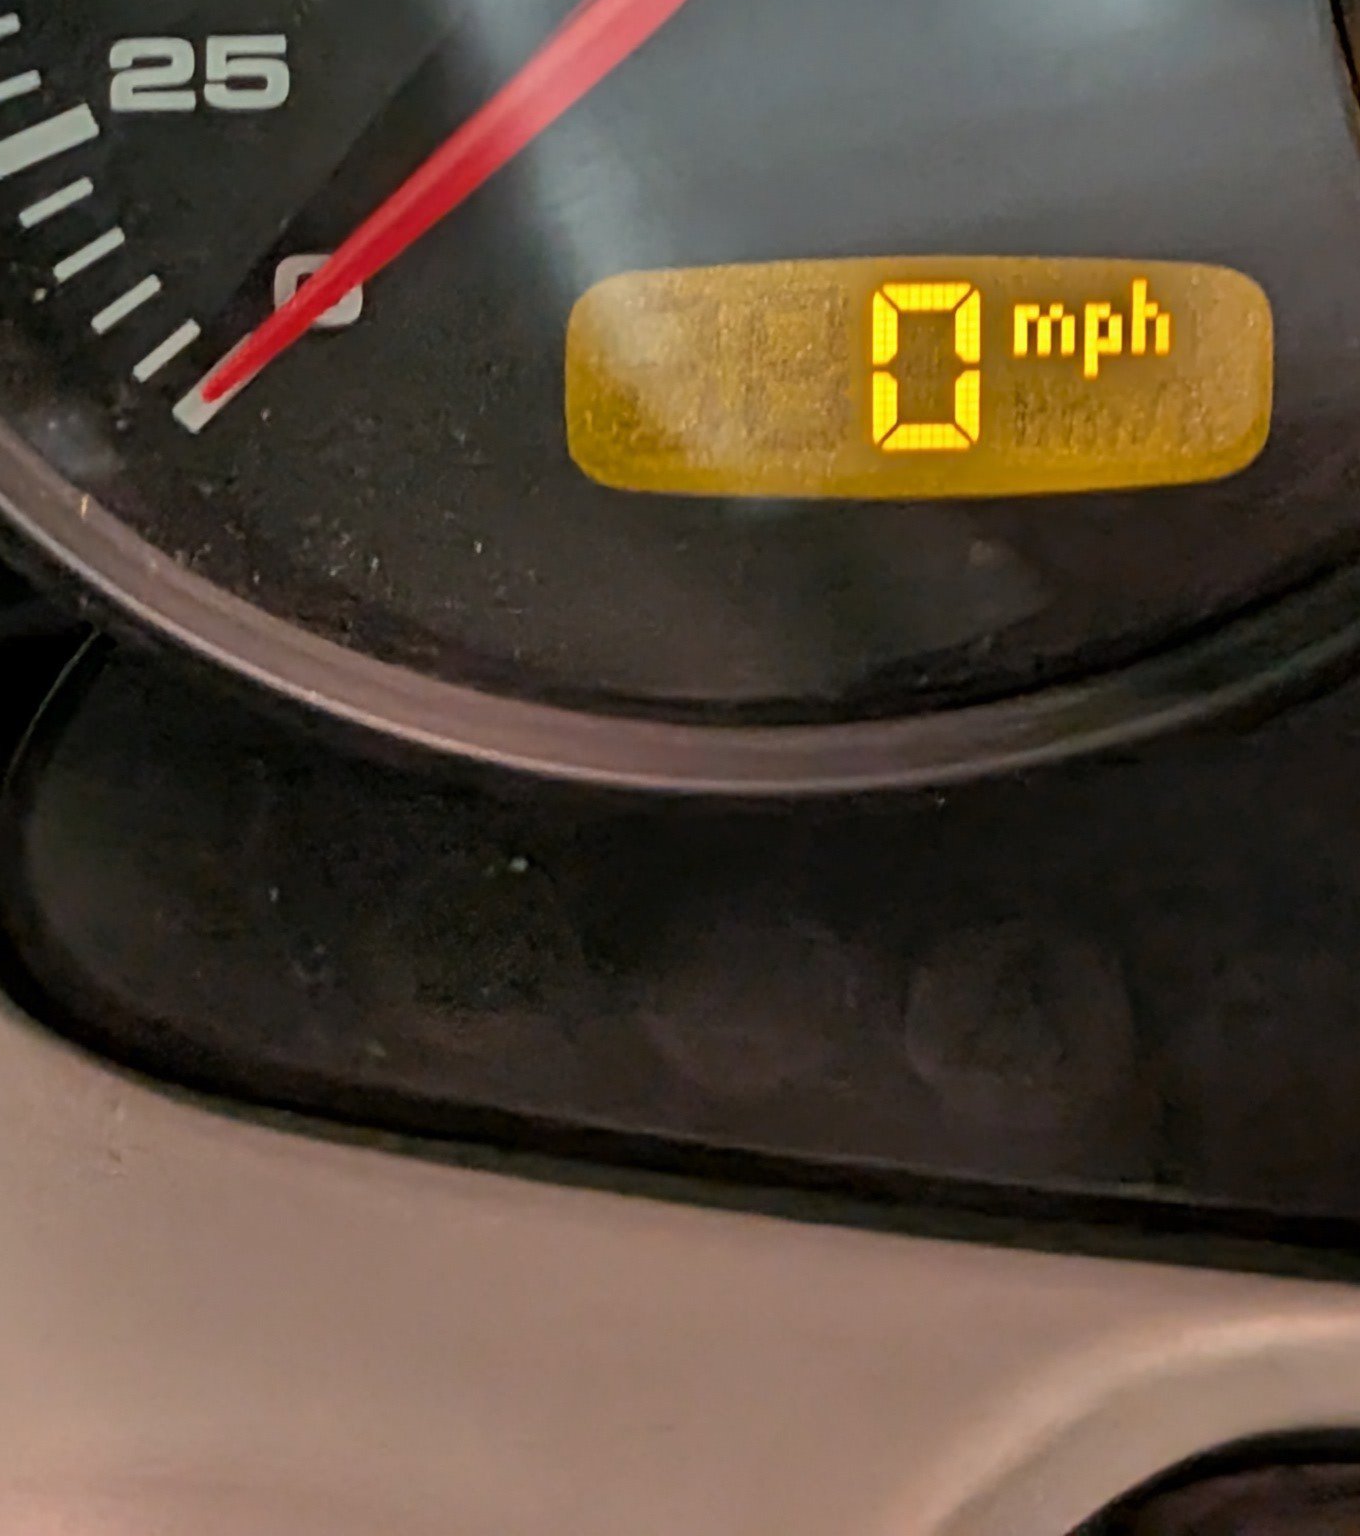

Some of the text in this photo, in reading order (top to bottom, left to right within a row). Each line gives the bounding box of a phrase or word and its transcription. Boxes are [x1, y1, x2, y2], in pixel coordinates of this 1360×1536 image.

[108, 34, 290, 112] 25
[273, 254, 364, 328] 0
[871, 278, 1172, 452] 0 mph
